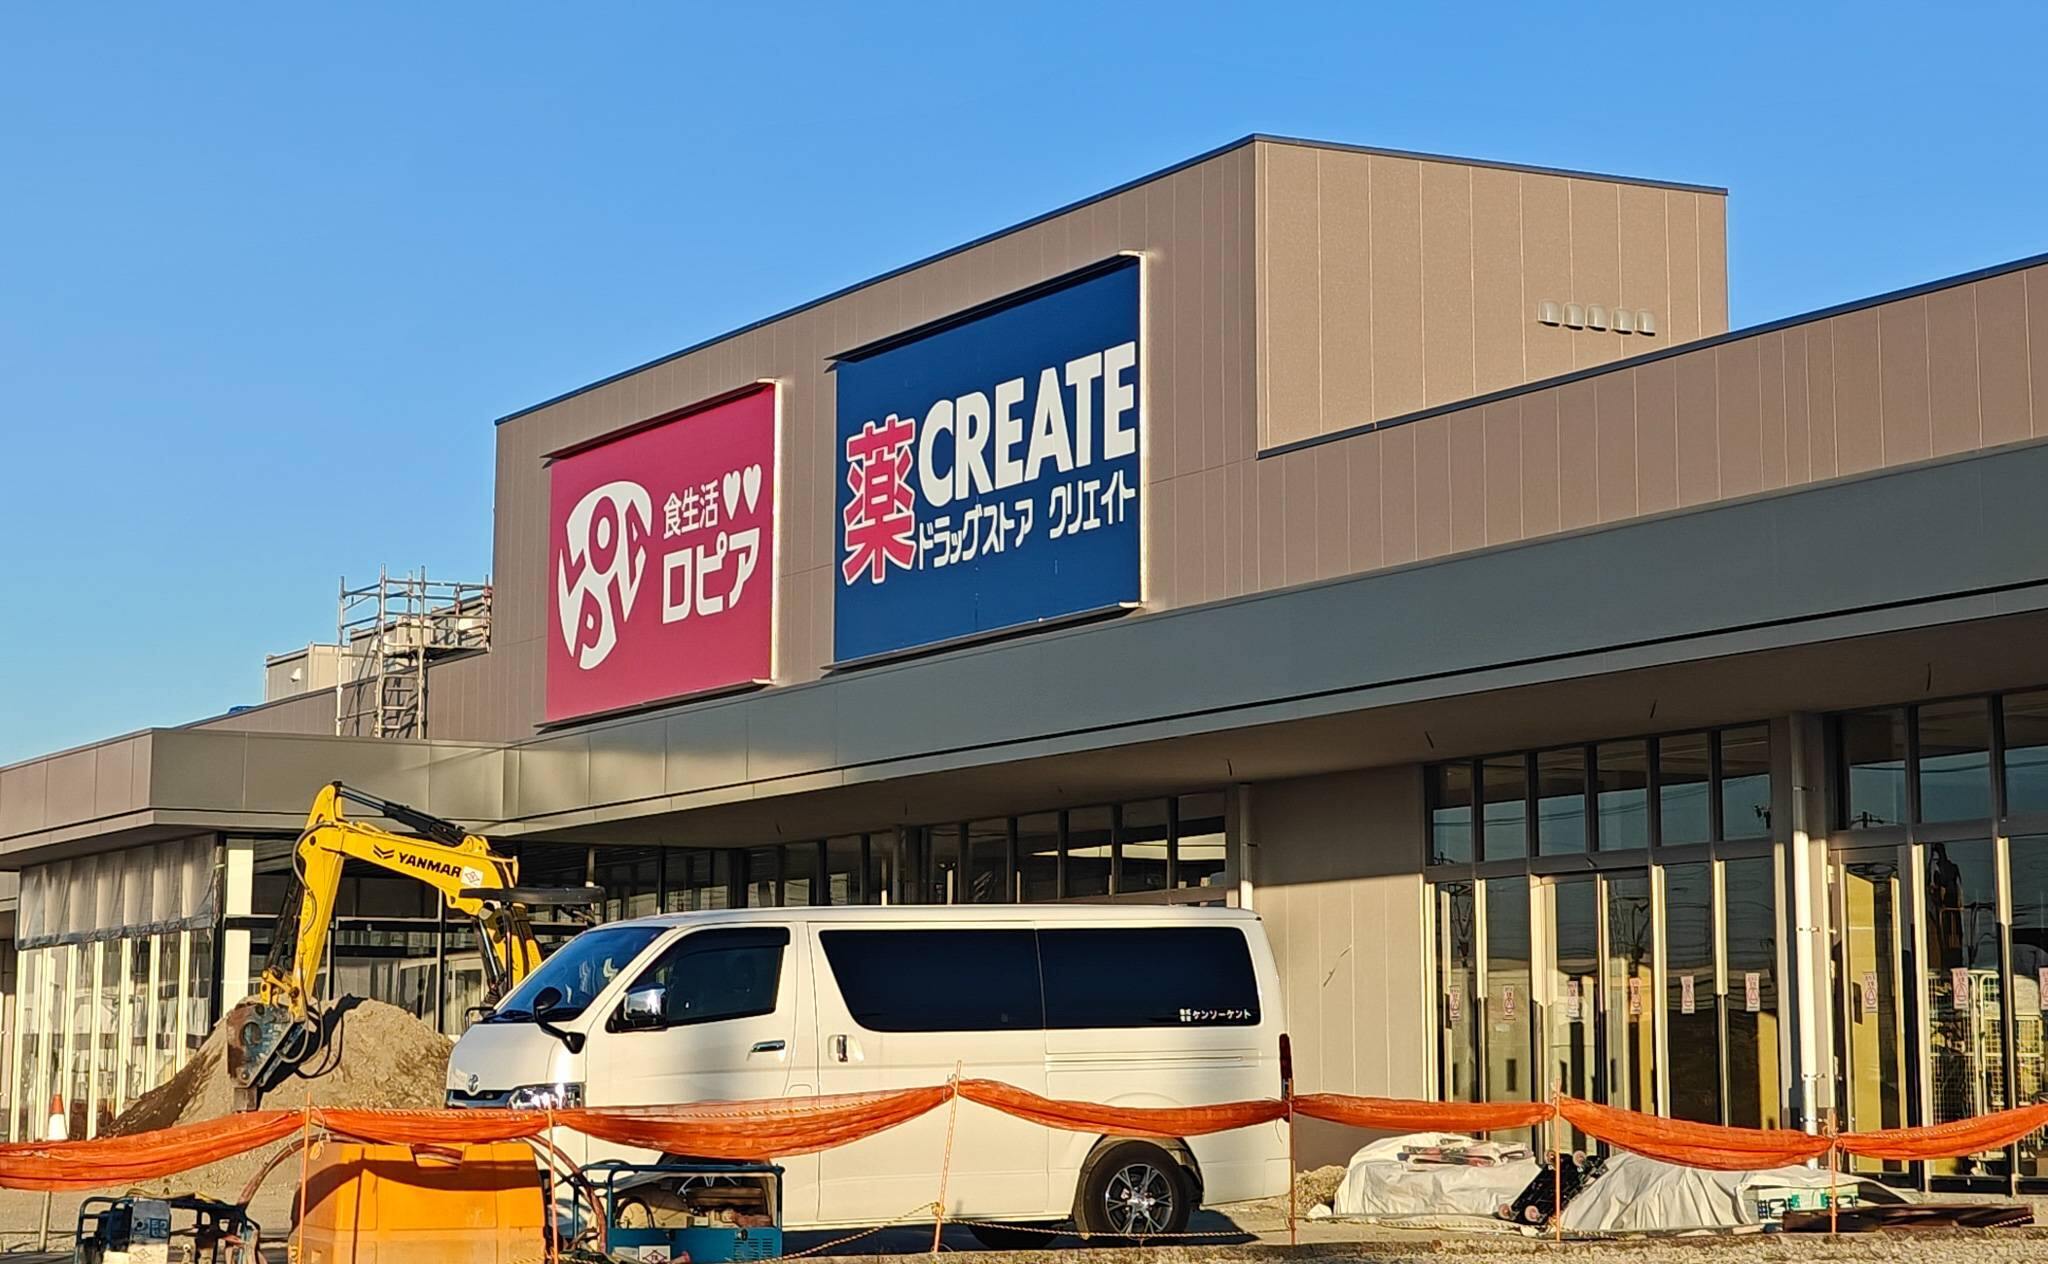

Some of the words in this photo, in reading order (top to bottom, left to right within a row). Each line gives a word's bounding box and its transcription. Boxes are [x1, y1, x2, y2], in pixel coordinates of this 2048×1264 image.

[919, 342, 1136, 507] CREATE
[663, 480, 719, 539] 食生活
[843, 414, 917, 585] 薬
[918, 499, 1034, 570] ドラッグストア
[1049, 470, 1136, 539] クリエイト
[663, 528, 760, 624] ロピア
[399, 853, 461, 877] YANMAR
[1193, 1009, 1252, 1020] ケンソーケント
